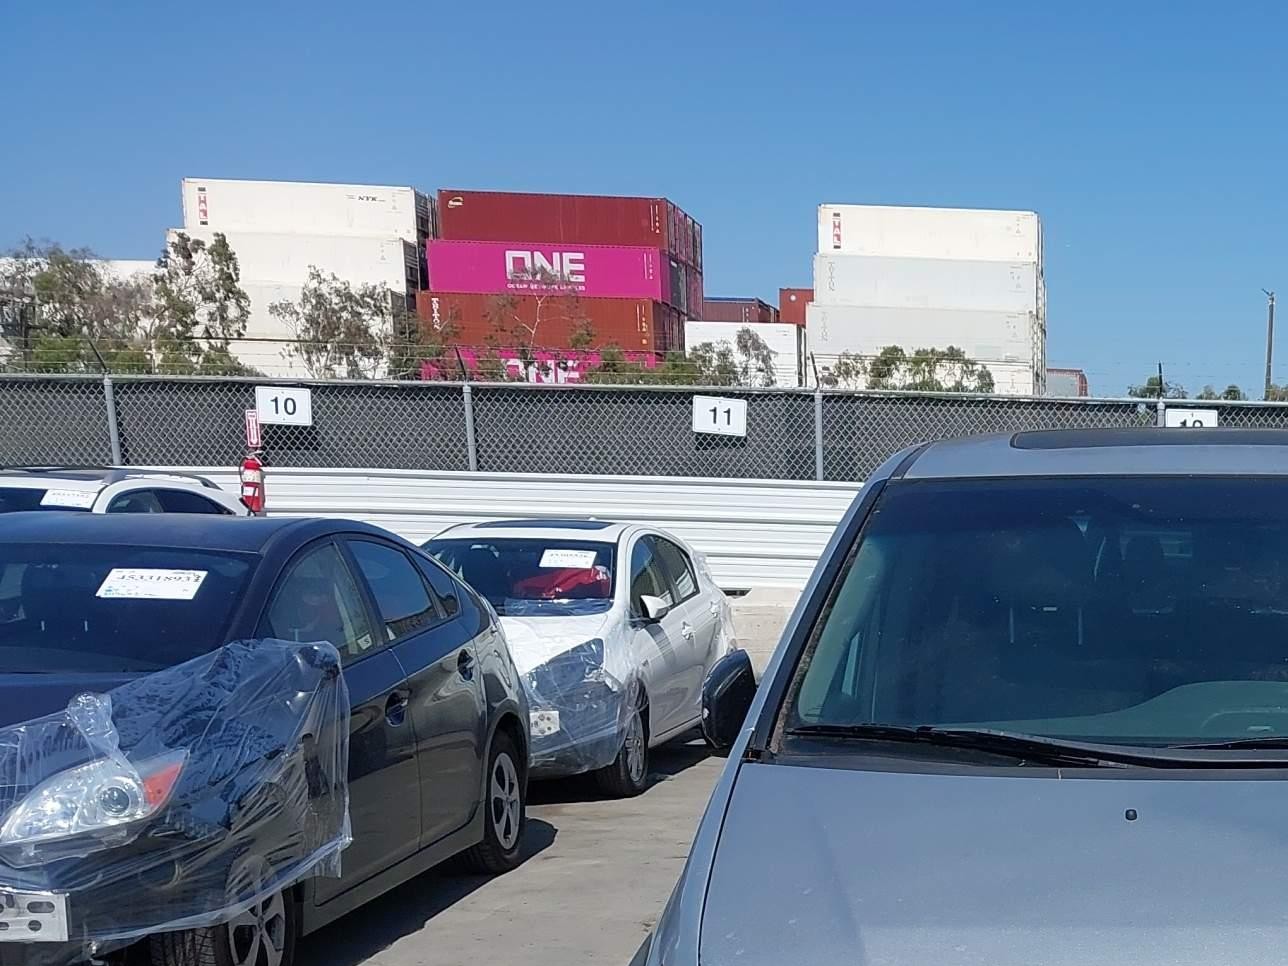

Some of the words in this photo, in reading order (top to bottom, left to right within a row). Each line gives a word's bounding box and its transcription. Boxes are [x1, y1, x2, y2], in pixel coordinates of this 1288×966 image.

[505, 250, 585, 282] ONE
[270, 396, 297, 416] 10
[709, 406, 731, 426] 11
